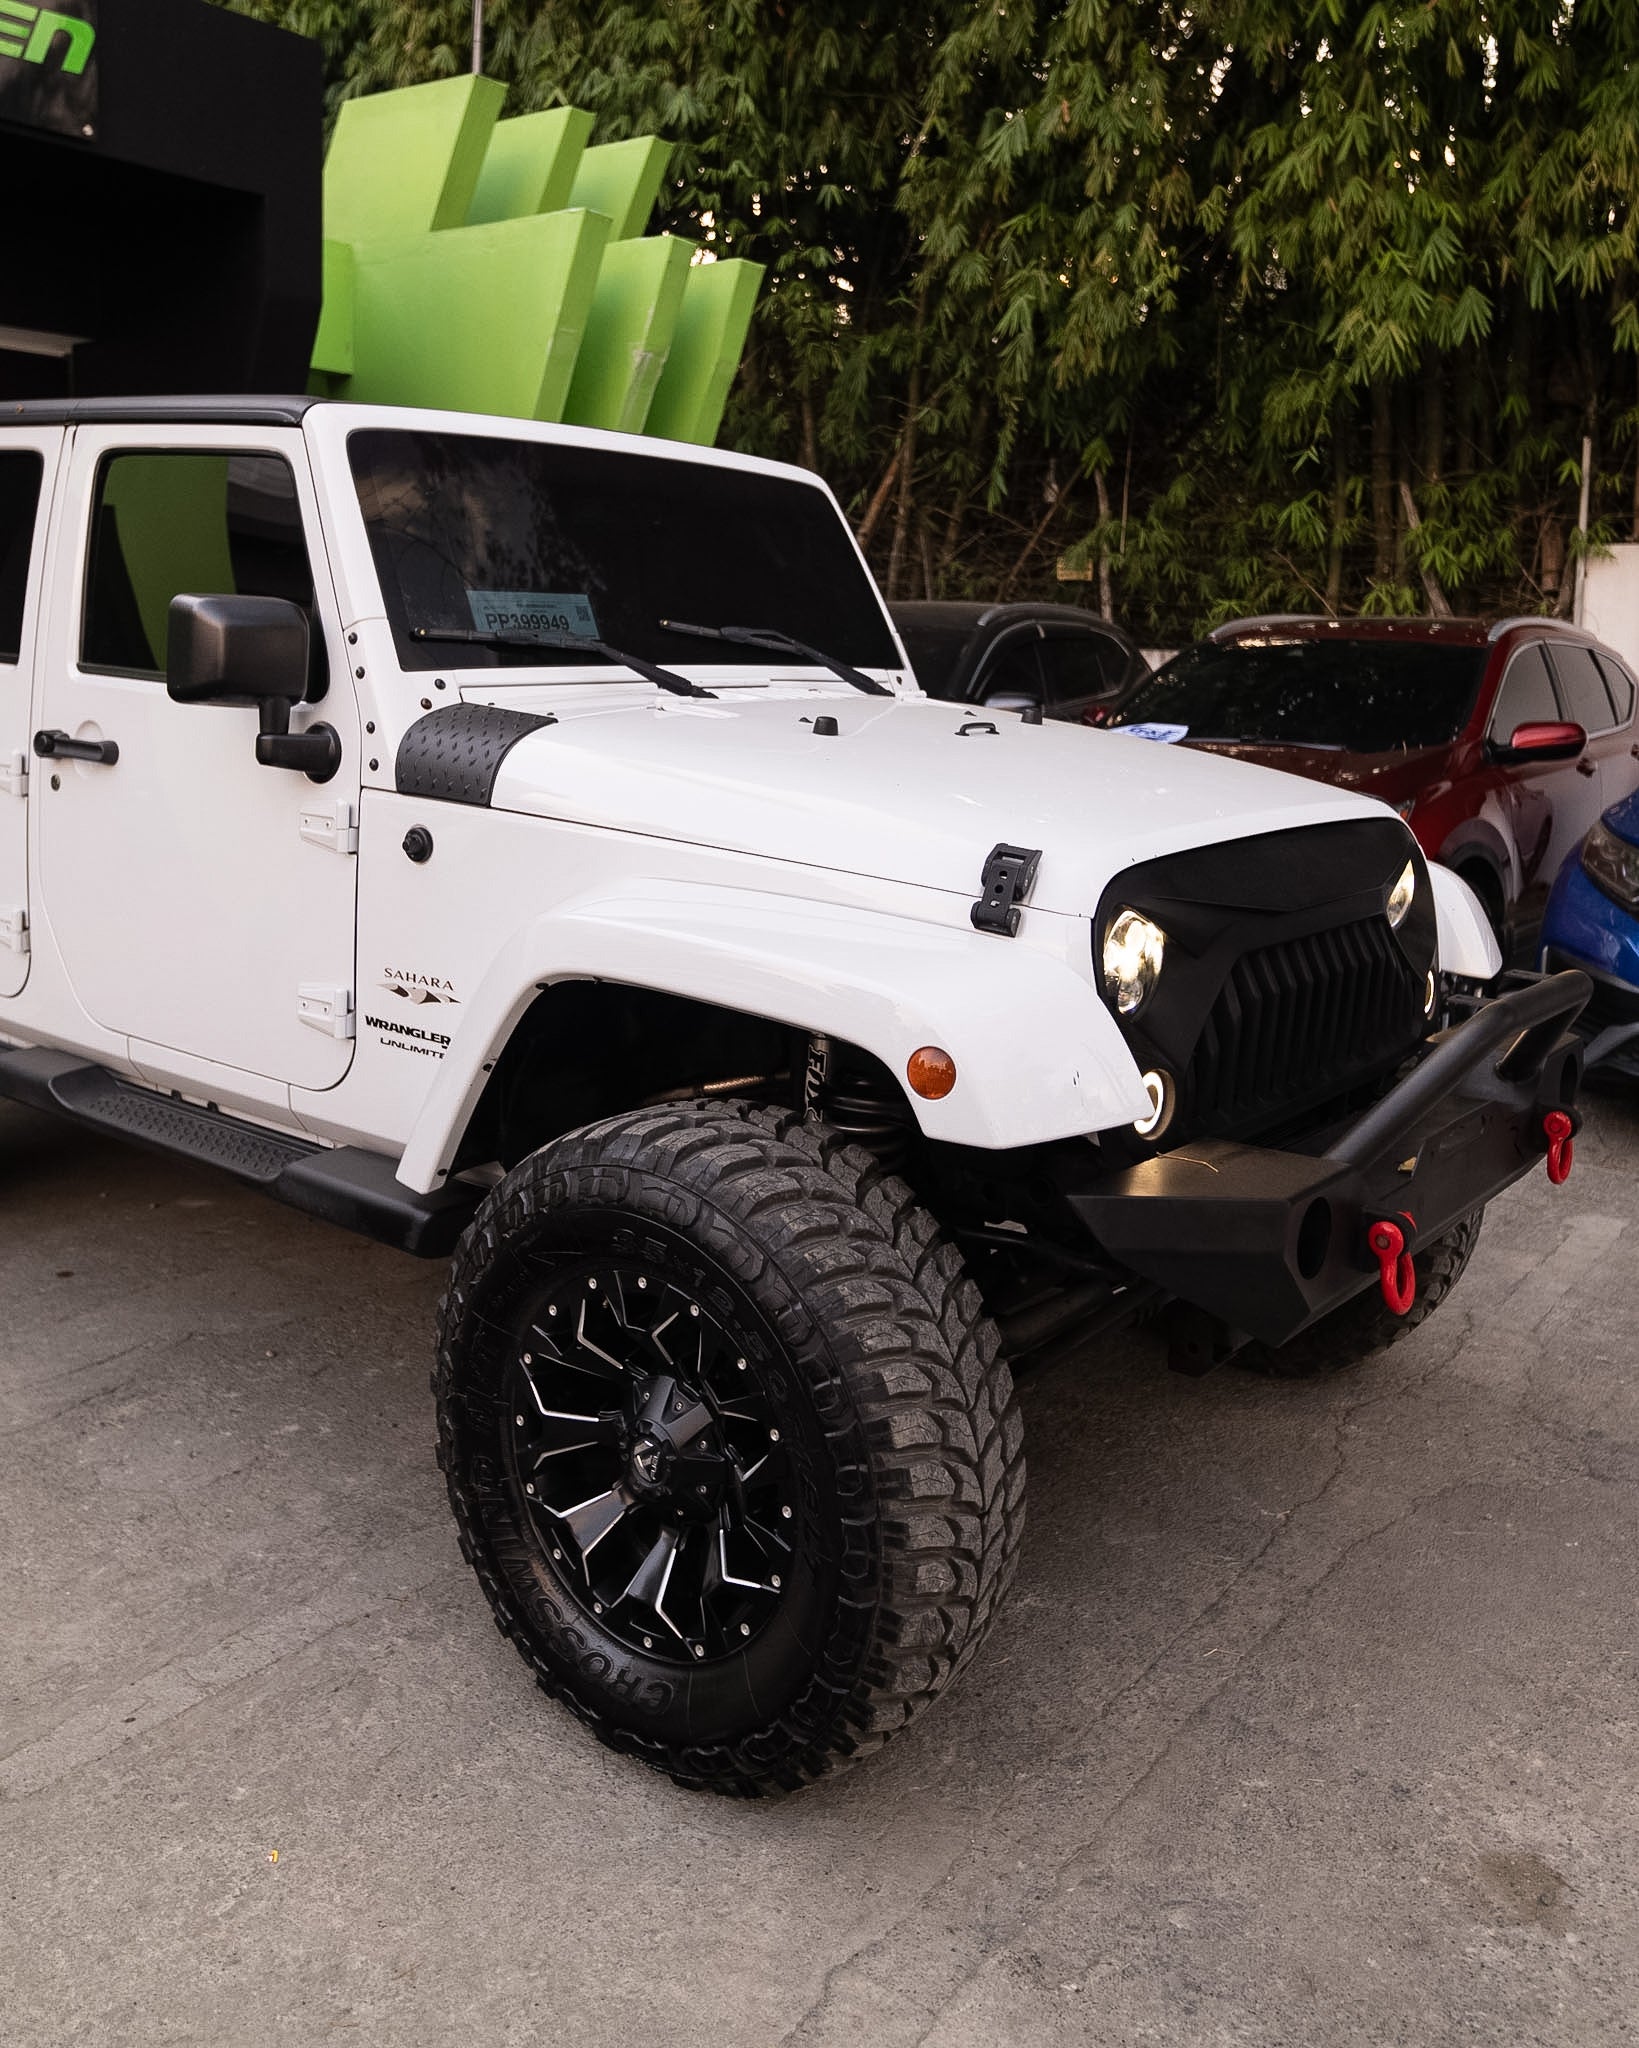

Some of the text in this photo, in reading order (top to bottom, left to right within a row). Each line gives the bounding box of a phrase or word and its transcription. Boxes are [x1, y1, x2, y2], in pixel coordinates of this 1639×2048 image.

[485, 613, 570, 631] PP399949
[384, 967, 454, 992] SAHARA
[365, 1015, 451, 1049] WRANGLER
[650, 1451, 661, 1481] FUEL
